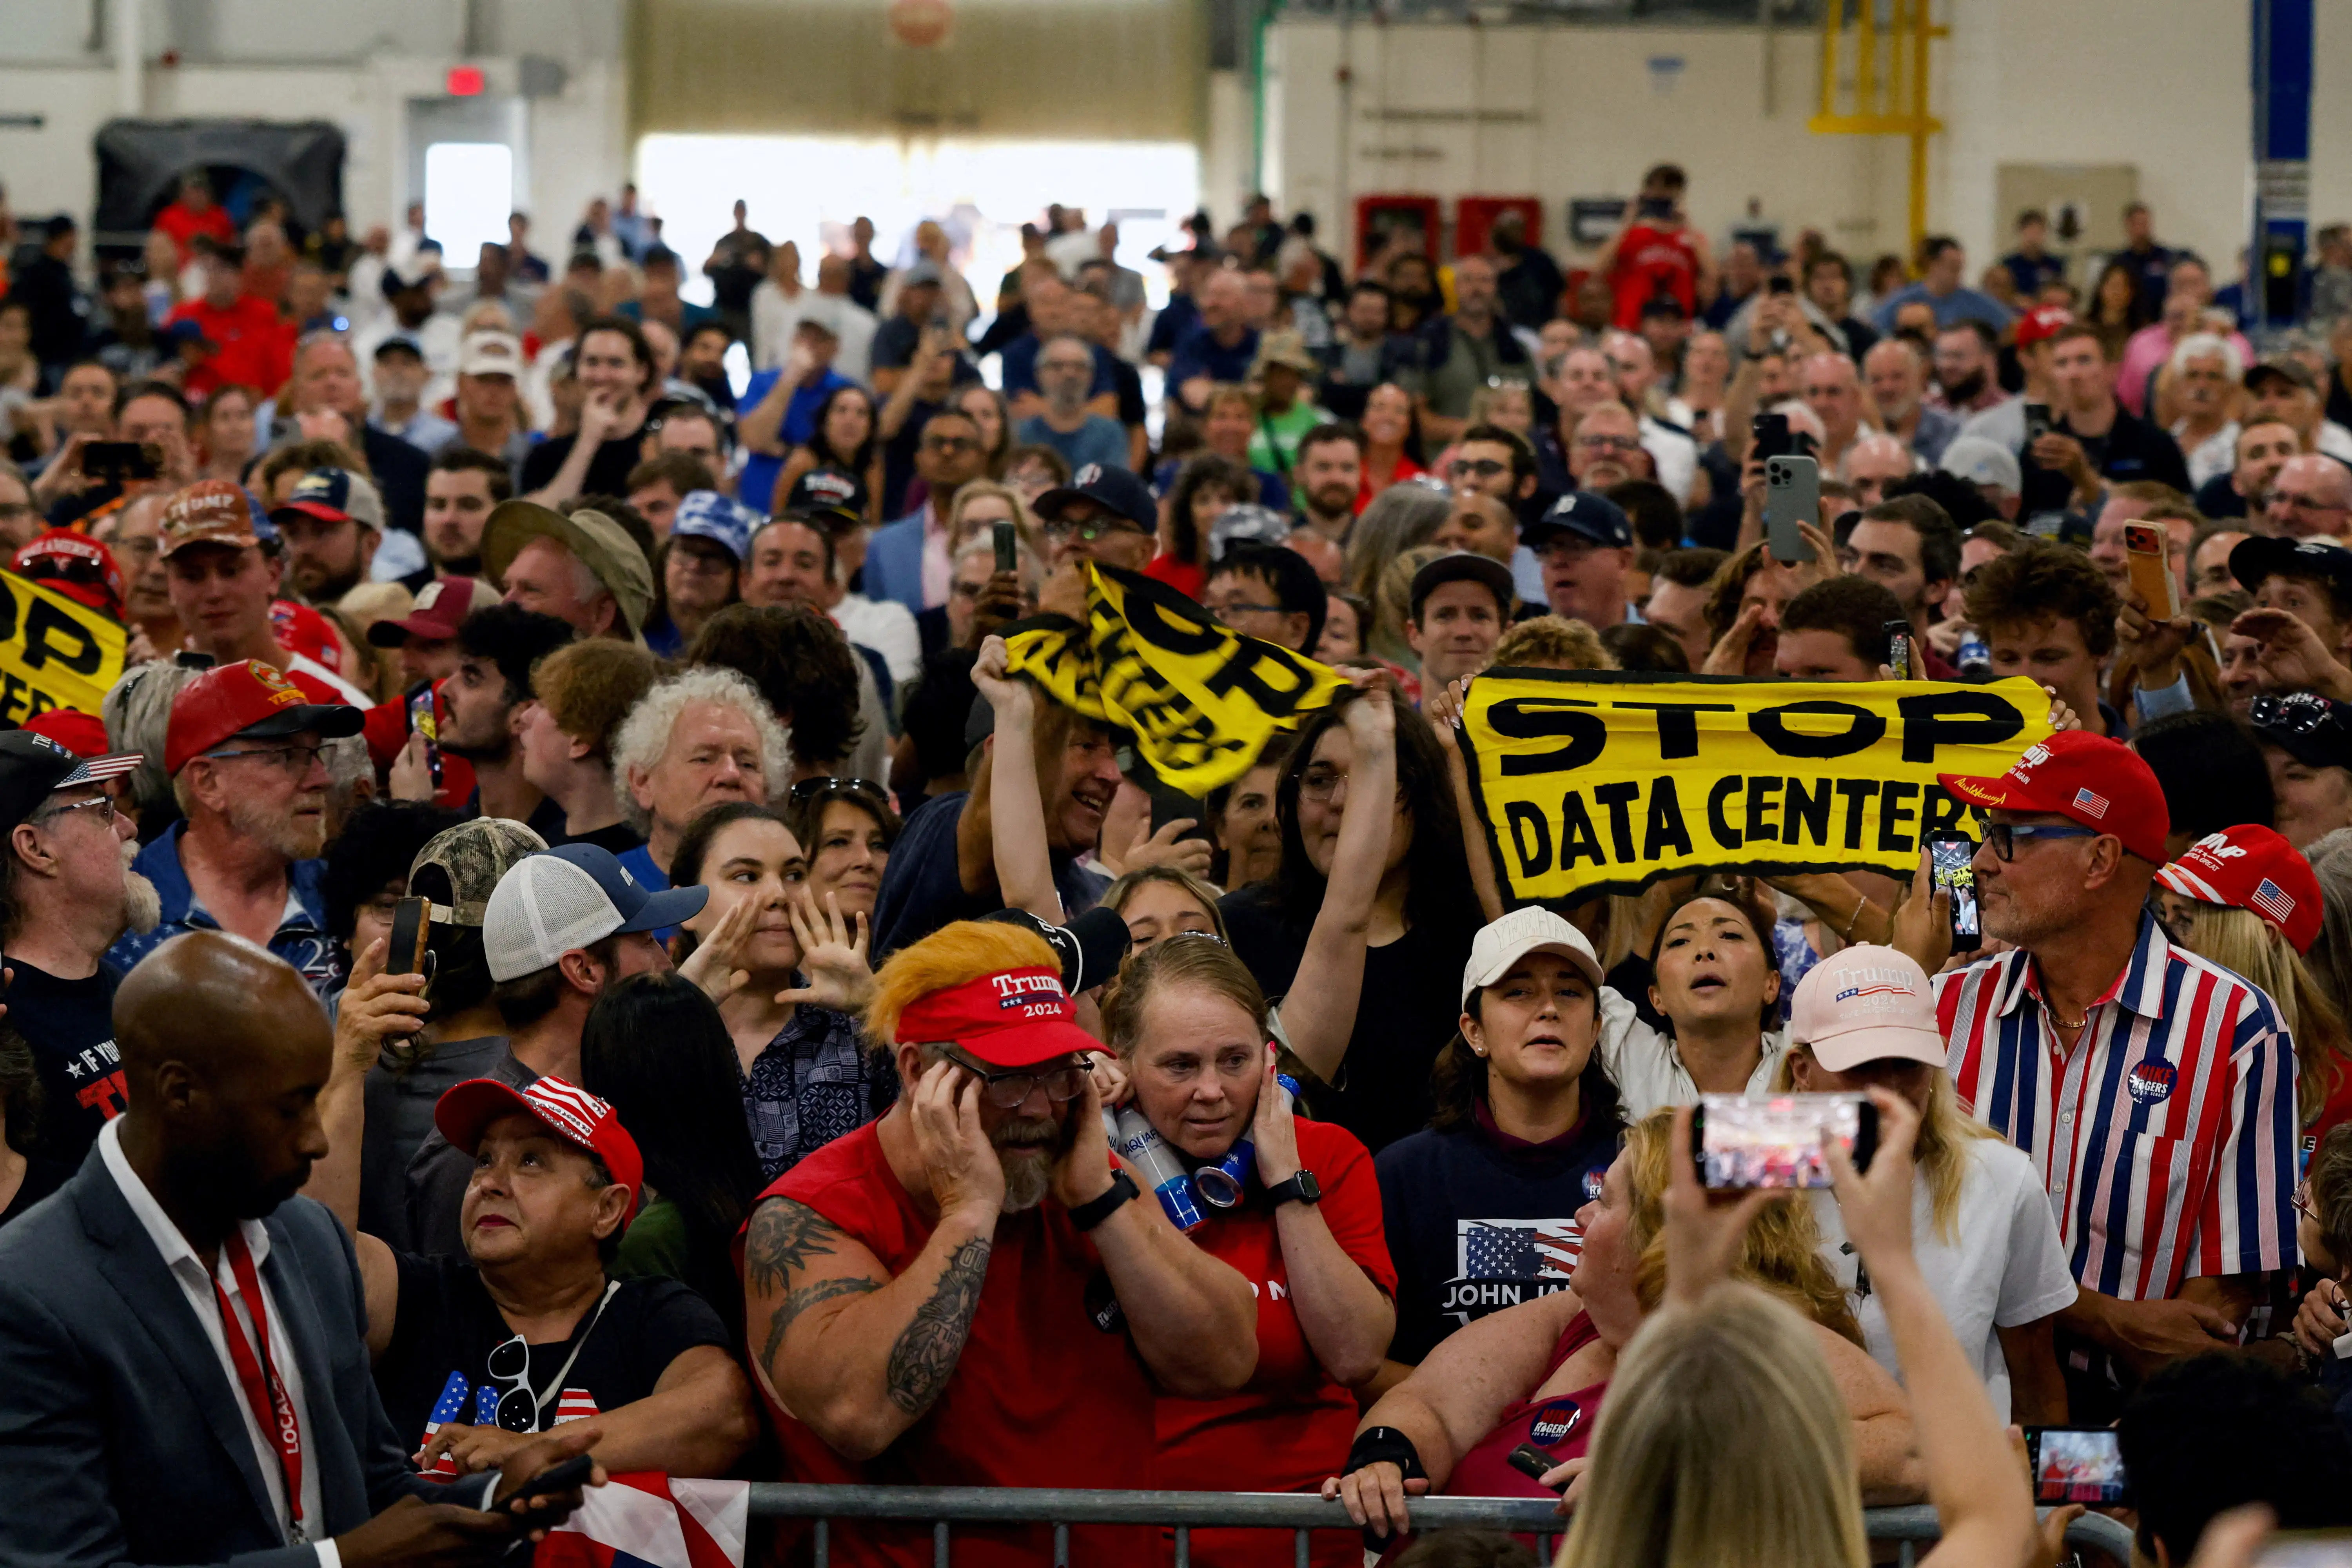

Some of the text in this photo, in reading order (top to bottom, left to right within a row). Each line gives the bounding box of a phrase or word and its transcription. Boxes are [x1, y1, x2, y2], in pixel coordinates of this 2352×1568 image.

[1487, 691, 2024, 776] STOP
[2014, 771, 2031, 784] AGAIN
[1504, 775, 1694, 878] DATA
[2199, 857, 2220, 871] GREAT
[992, 974, 1063, 998] Trump
[1833, 967, 1914, 990] Trump
[1024, 1003, 1062, 1017] 2024
[1863, 995, 1898, 1007] 2024
[79, 1049, 100, 1073] IF
[2137, 1064, 2174, 1085] MIKE
[1442, 1284, 1570, 1308] JOHN JA
[1534, 1421, 1569, 1434] ROGERS
